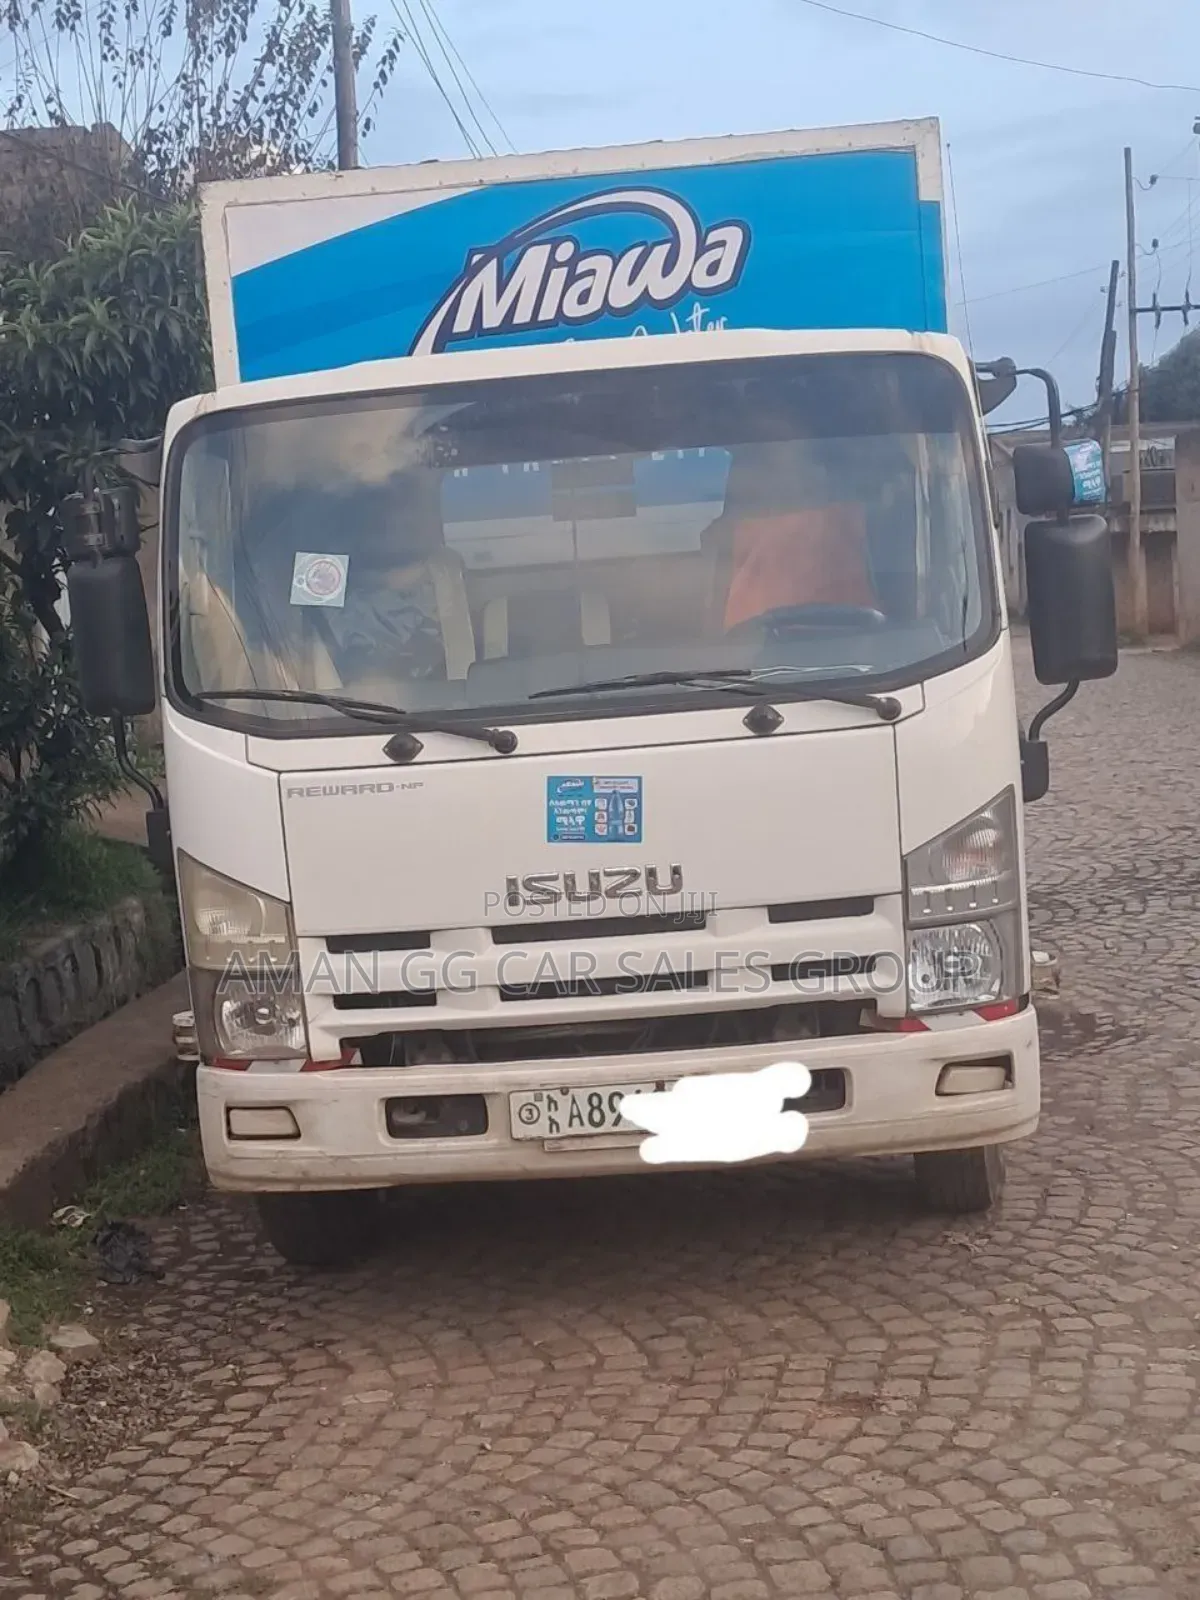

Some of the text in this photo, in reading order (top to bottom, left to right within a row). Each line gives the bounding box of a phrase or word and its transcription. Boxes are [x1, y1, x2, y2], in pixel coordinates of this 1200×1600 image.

[409, 186, 751, 356] Miawa
[506, 863, 683, 907] ISUZU
[567, 1090, 641, 1128] A89
